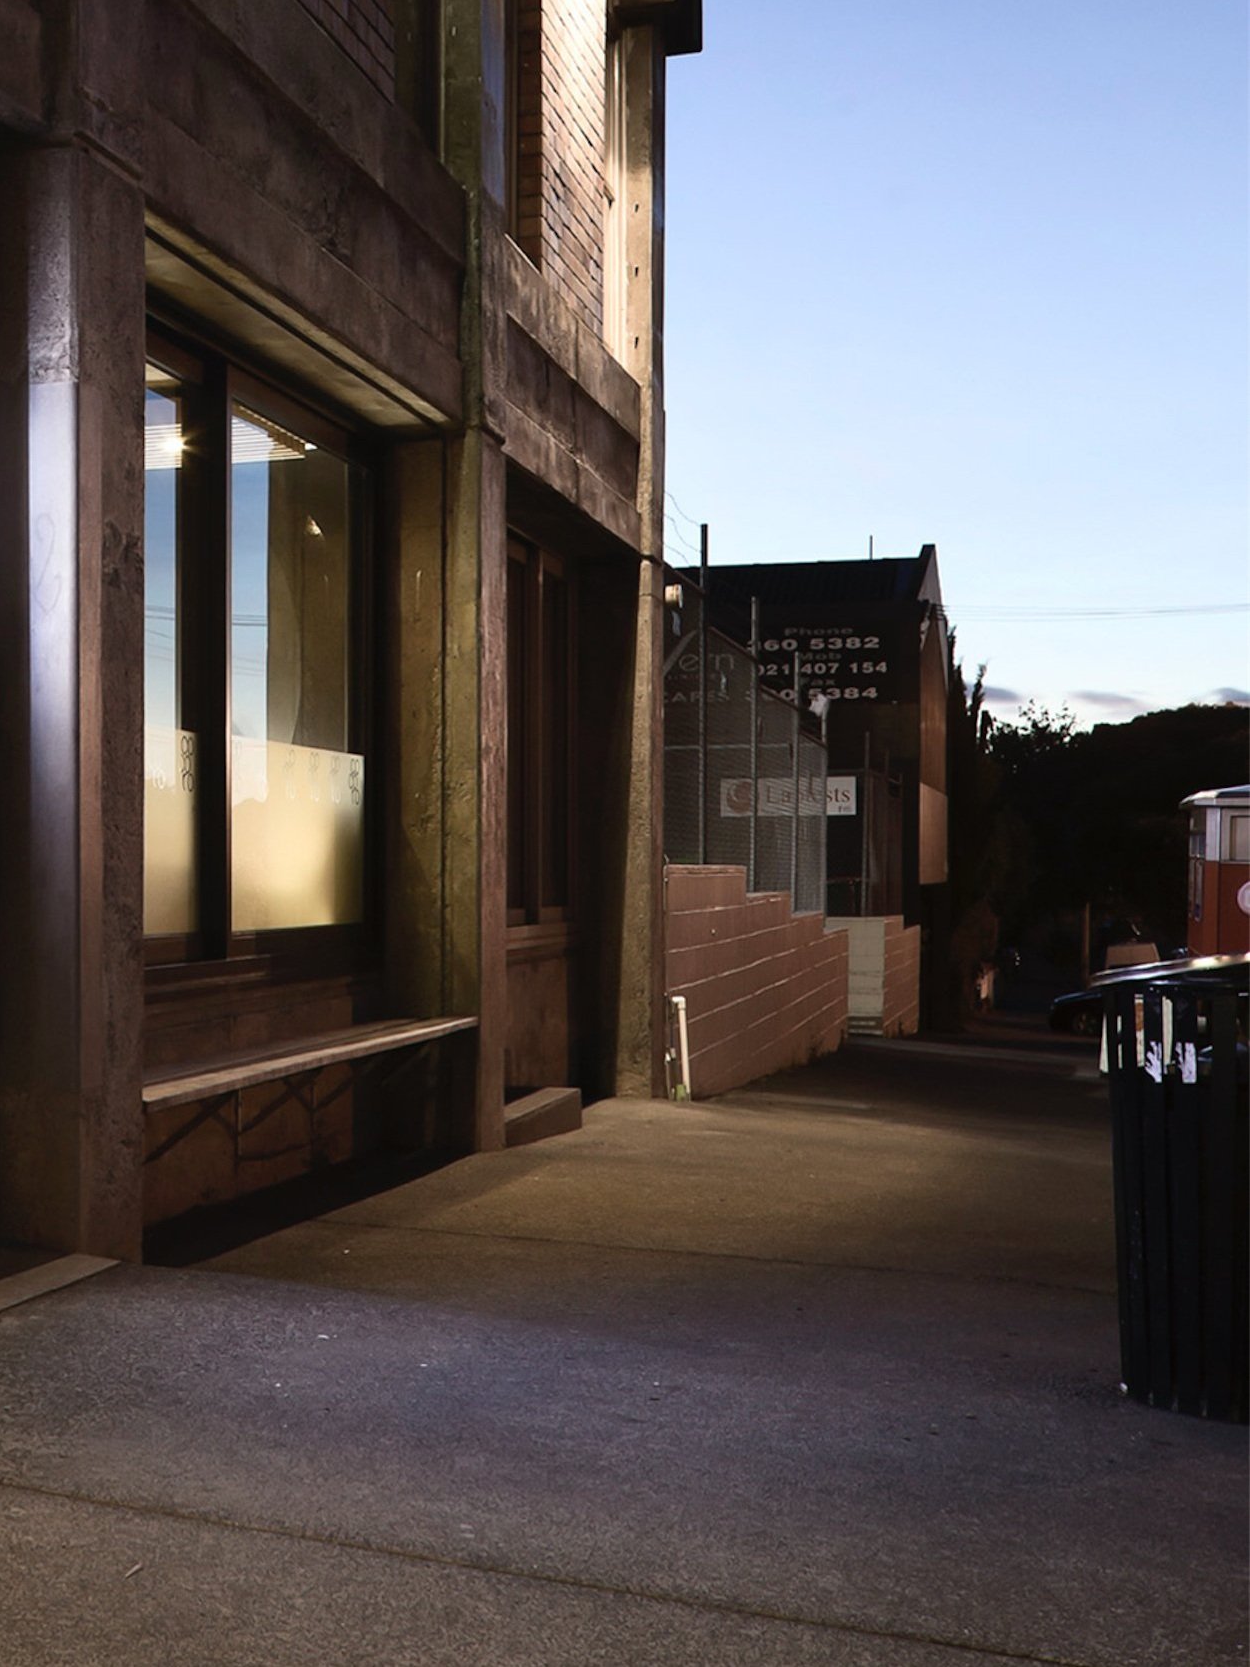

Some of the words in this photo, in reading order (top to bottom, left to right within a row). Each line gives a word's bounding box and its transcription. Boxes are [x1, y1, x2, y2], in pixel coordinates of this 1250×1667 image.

[783, 627, 854, 636] Phone
[809, 635, 881, 650] 5382
[800, 662, 840, 675] 407
[849, 661, 888, 674] 154
[808, 686, 879, 700] 5384
